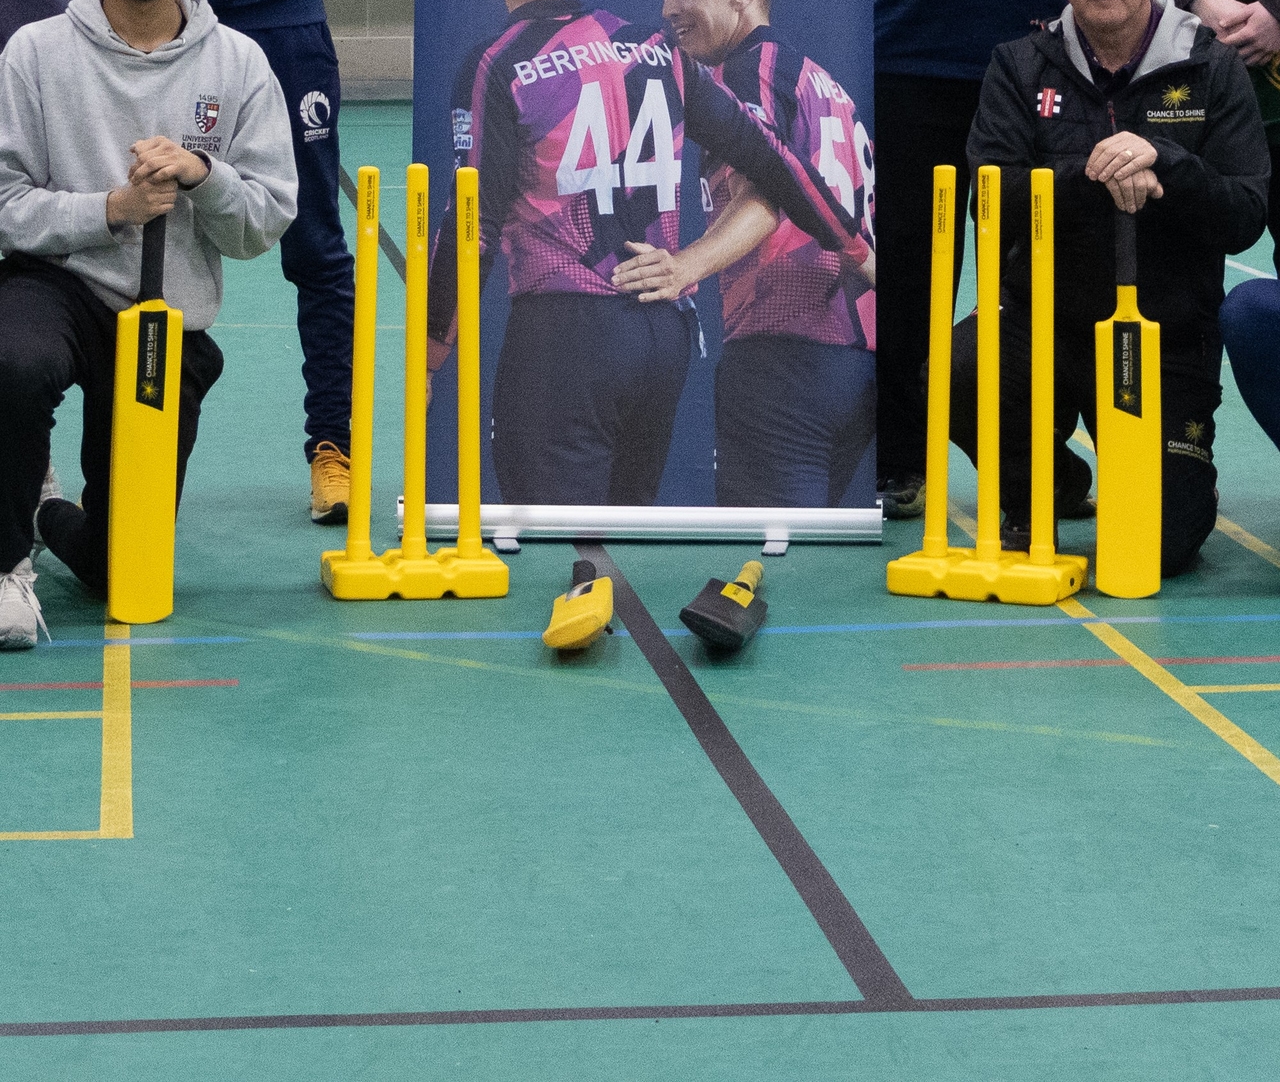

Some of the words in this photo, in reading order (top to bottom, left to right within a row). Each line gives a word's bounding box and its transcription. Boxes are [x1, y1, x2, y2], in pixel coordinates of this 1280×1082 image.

[512, 40, 674, 86] BERRINGTON
[198, 93, 219, 103] 1495
[1175, 109, 1185, 117] TO
[1185, 108, 1205, 116] SHINE
[304, 127, 330, 137] CRICKET
[304, 134, 329, 143] SCOTLAND
[555, 78, 683, 216] 44
[147, 322, 155, 342] SHINE
[147, 341, 154, 351] TO
[1122, 350, 1129, 359] TO
[1167, 440, 1194, 452] CHANCE
